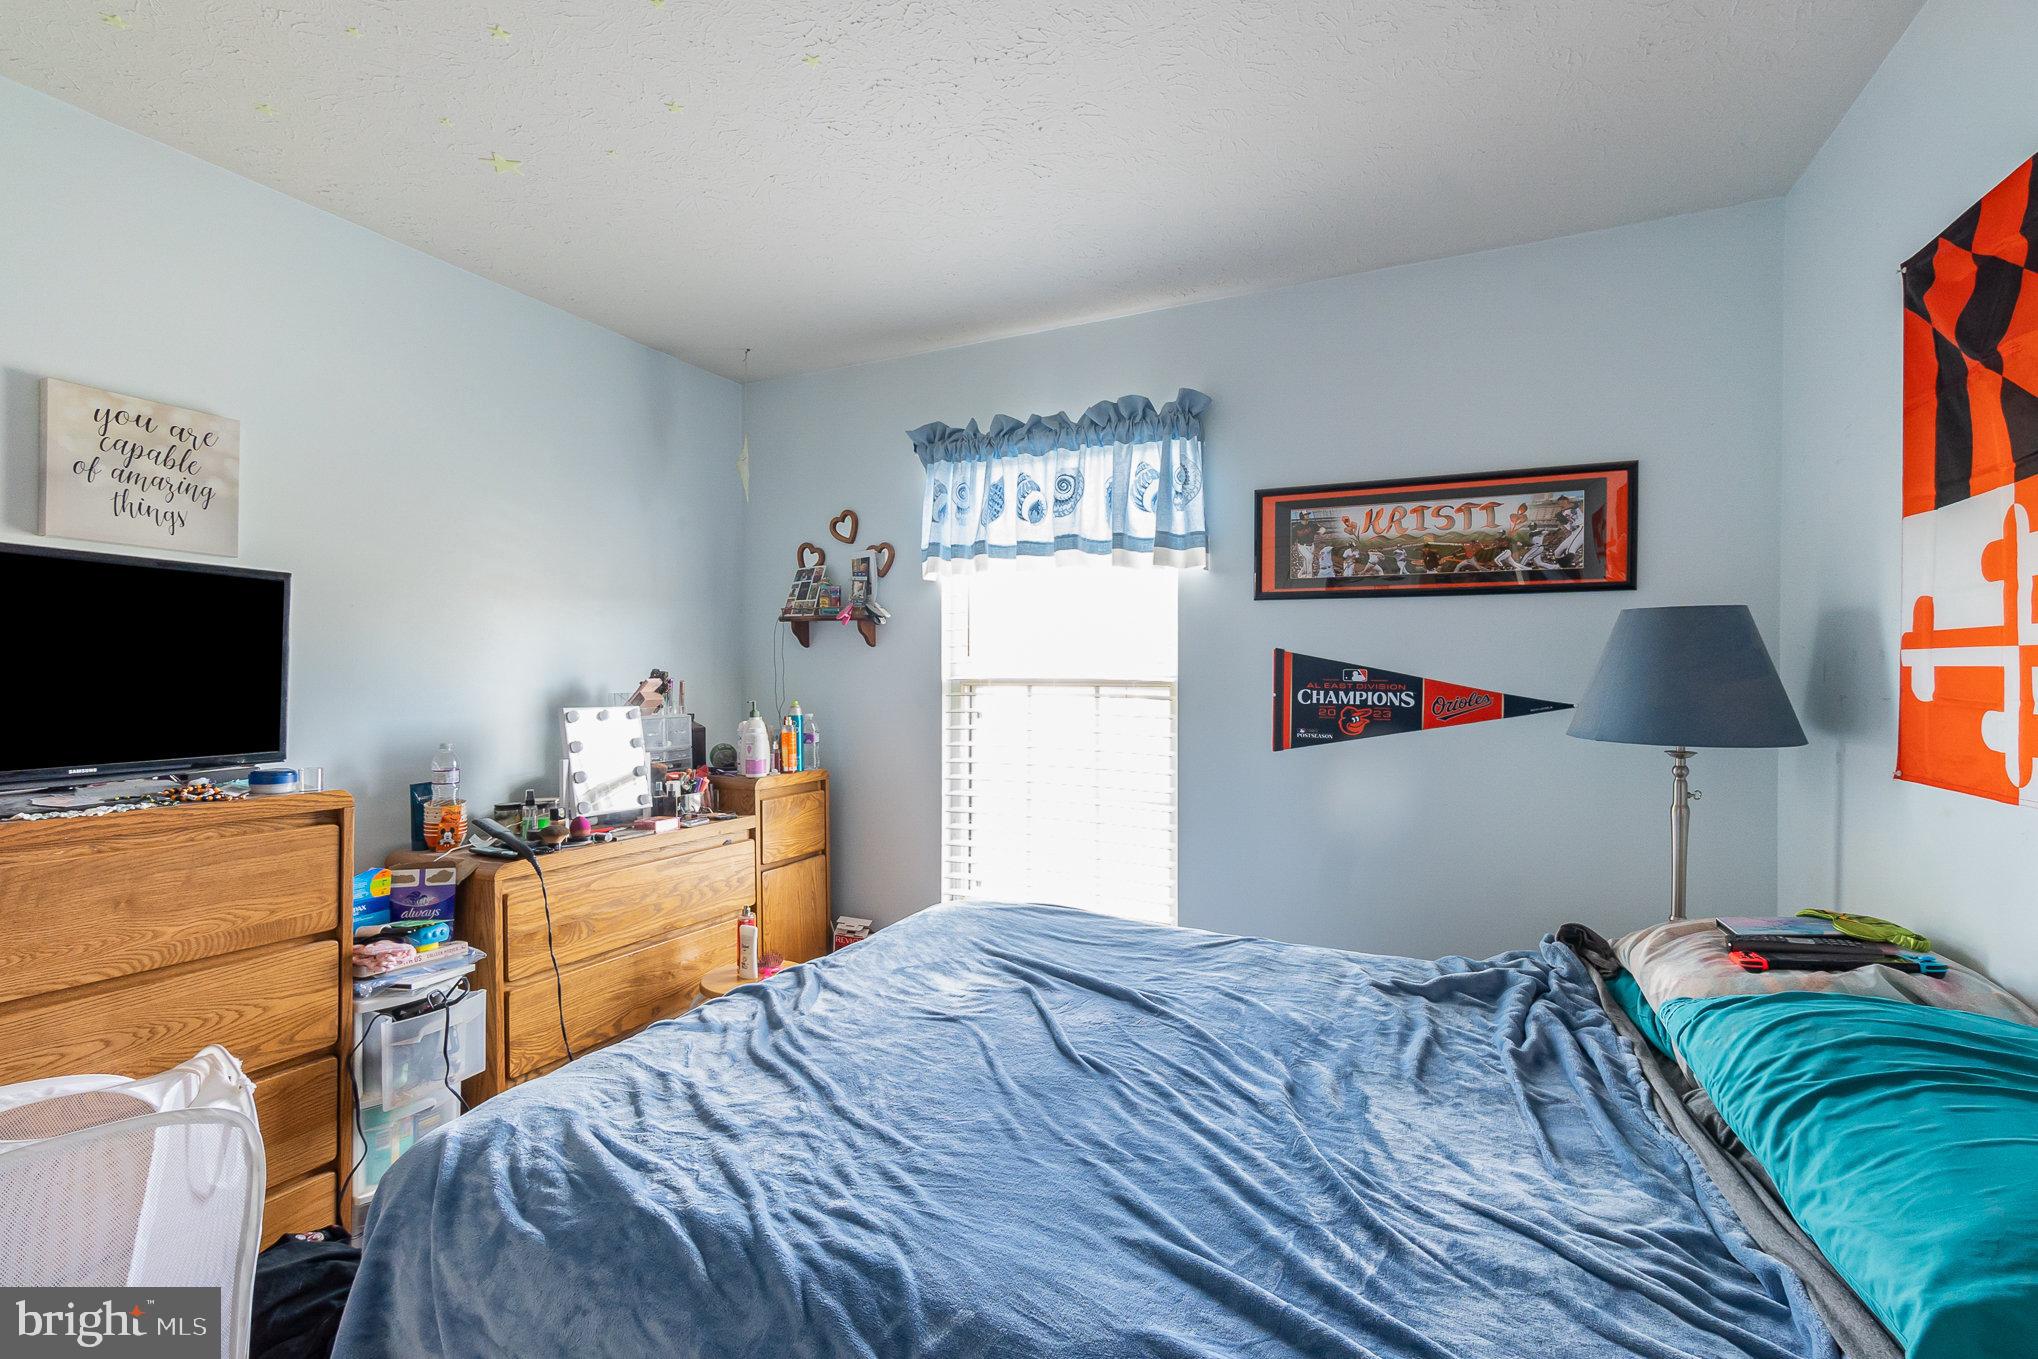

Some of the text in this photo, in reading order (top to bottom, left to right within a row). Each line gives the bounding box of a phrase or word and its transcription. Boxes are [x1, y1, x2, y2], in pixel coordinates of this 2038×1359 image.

[93, 408, 219, 451] you are
[99, 435, 202, 476] capable
[72, 456, 216, 510] of amazing
[109, 488, 188, 536] things
[1361, 501, 1505, 535] KRISTI
[1297, 688, 1416, 708] CHAMPIONS
[1356, 683, 1407, 691] DIVISION
[1318, 708, 1392, 718] 20 23
[1432, 692, 1493, 716] Orioles
[1296, 732, 1333, 740] POSTSEASON
[68, 767, 97, 775] SAMSUNG
[401, 906, 441, 920] always
